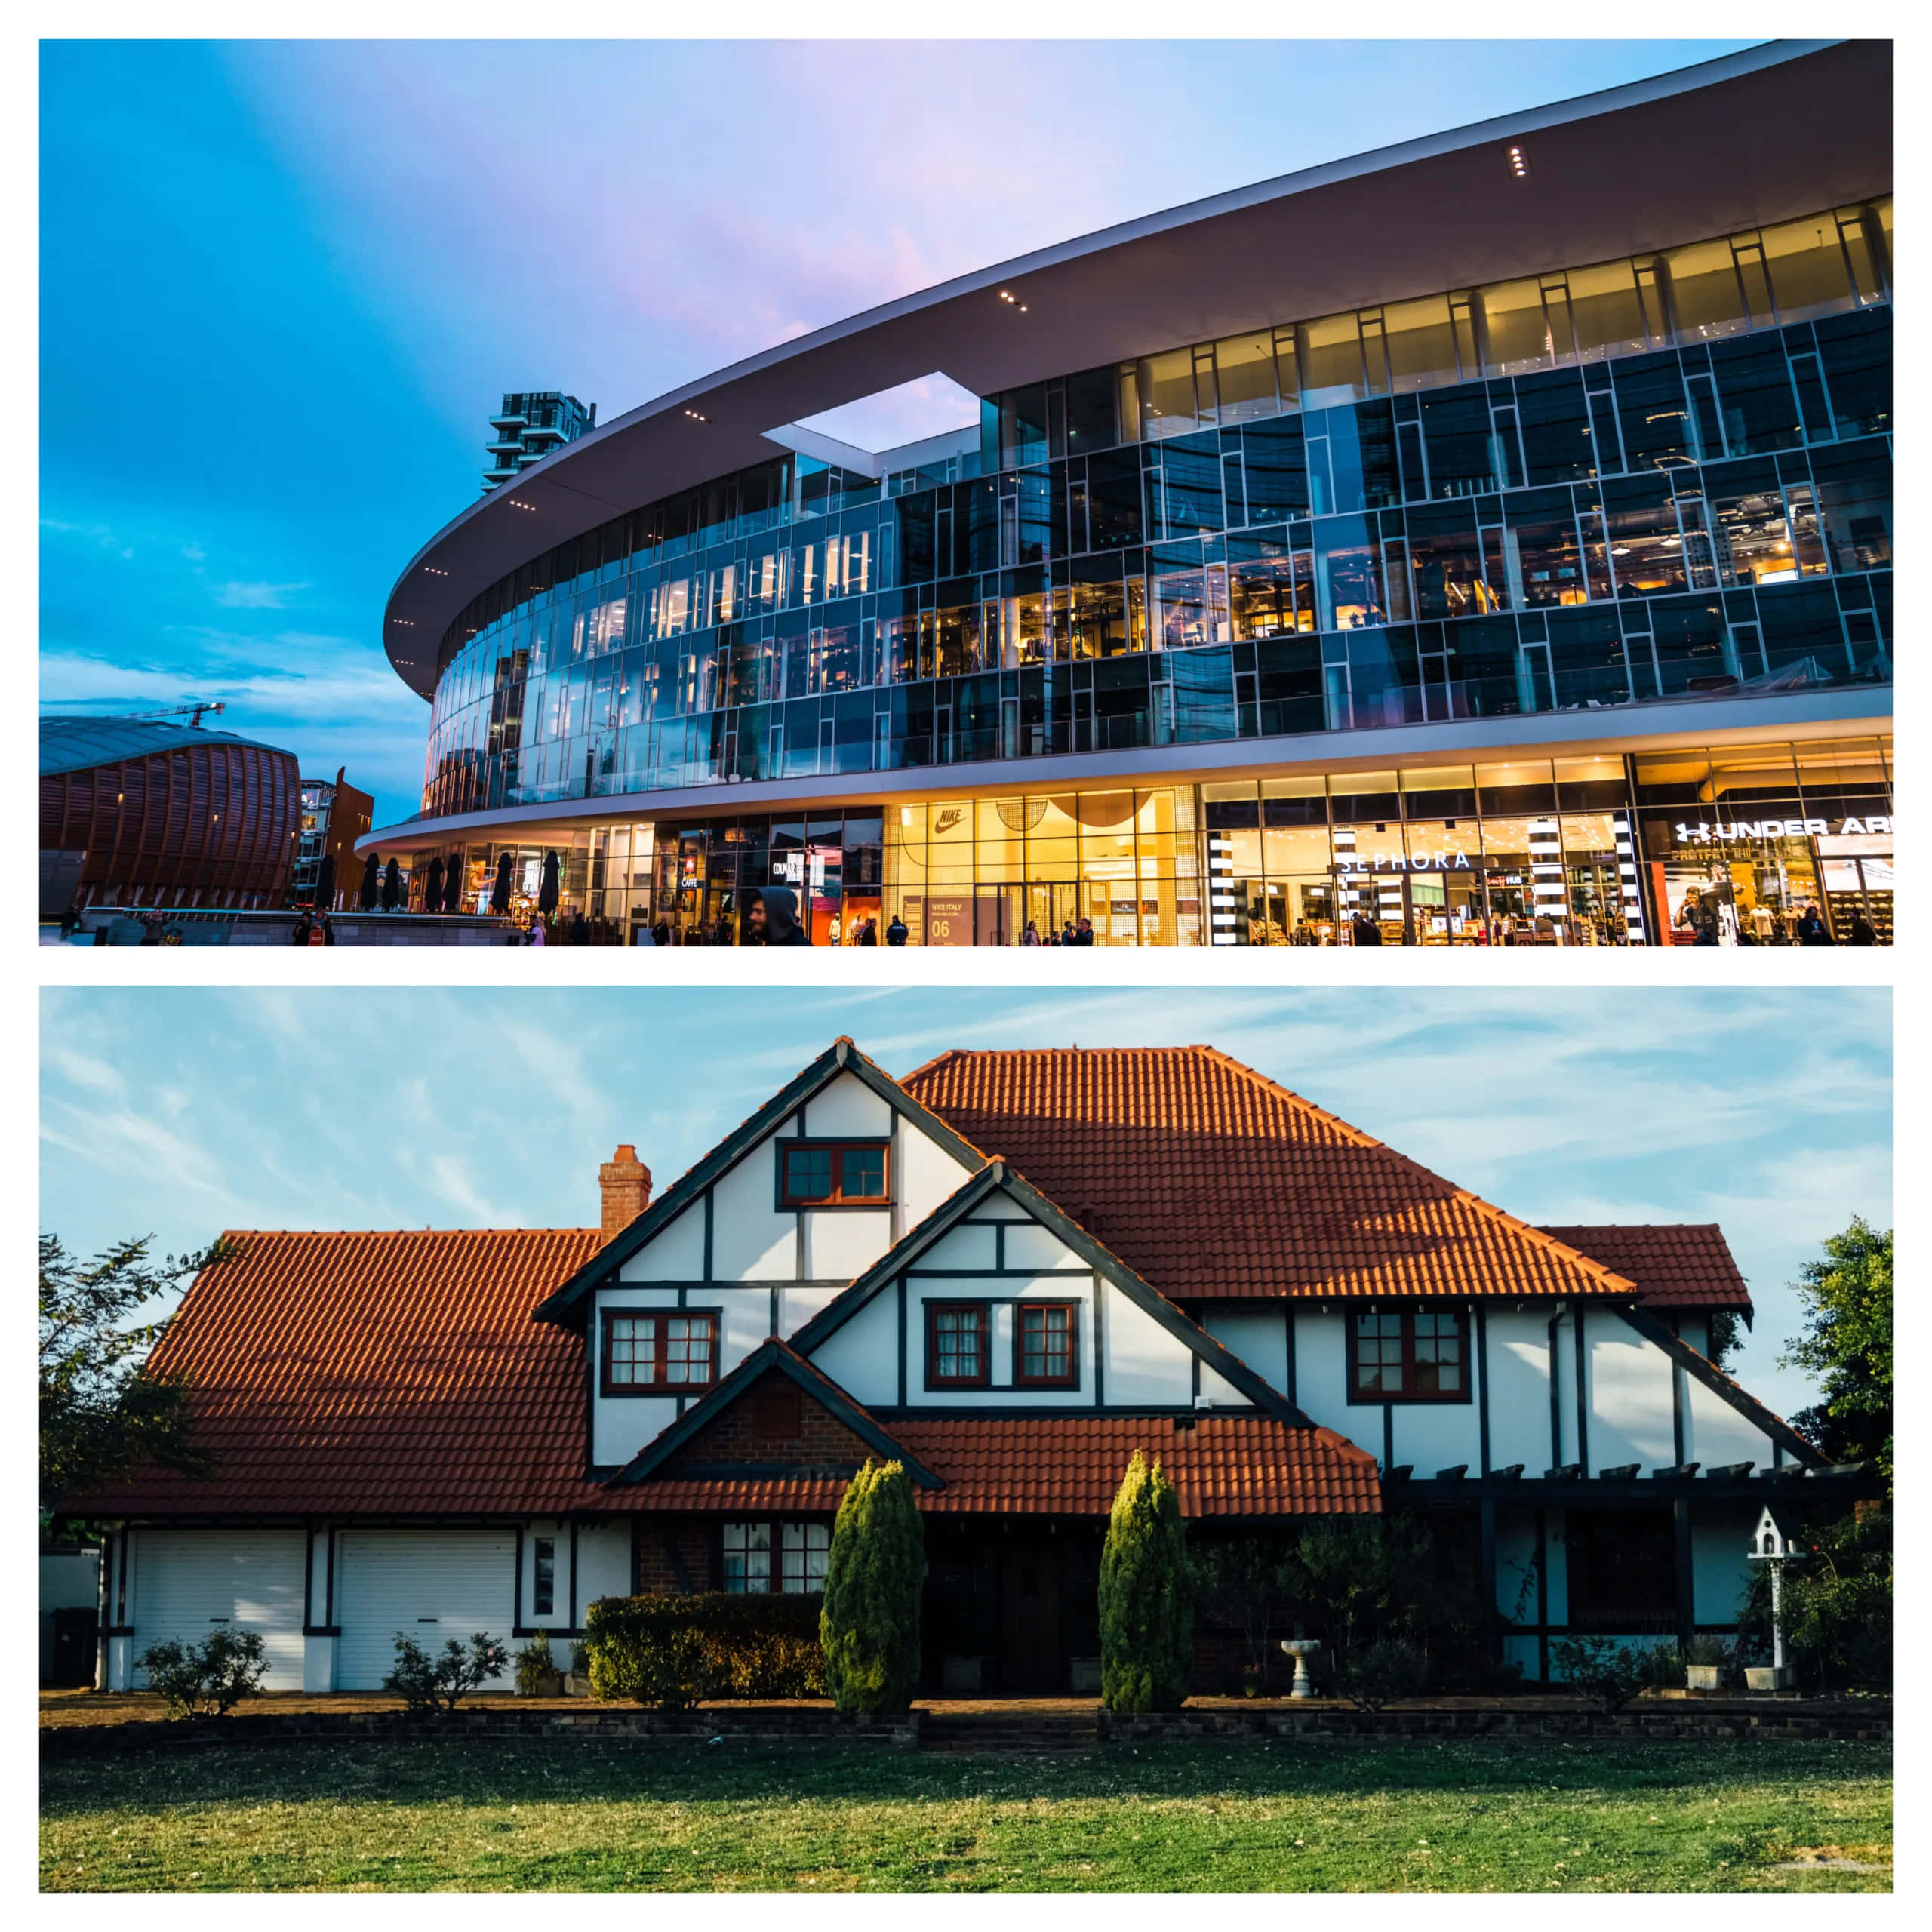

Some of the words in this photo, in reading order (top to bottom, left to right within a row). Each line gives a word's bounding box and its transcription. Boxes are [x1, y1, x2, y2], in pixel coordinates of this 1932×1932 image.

[940, 809, 962, 823] NIKE
[1715, 820, 1829, 839] UNDER
[773, 863, 797, 875] COLMAR
[1340, 851, 1470, 872] SEPHORA
[1506, 875, 1523, 884] HUB
[932, 921, 949, 937] 06
